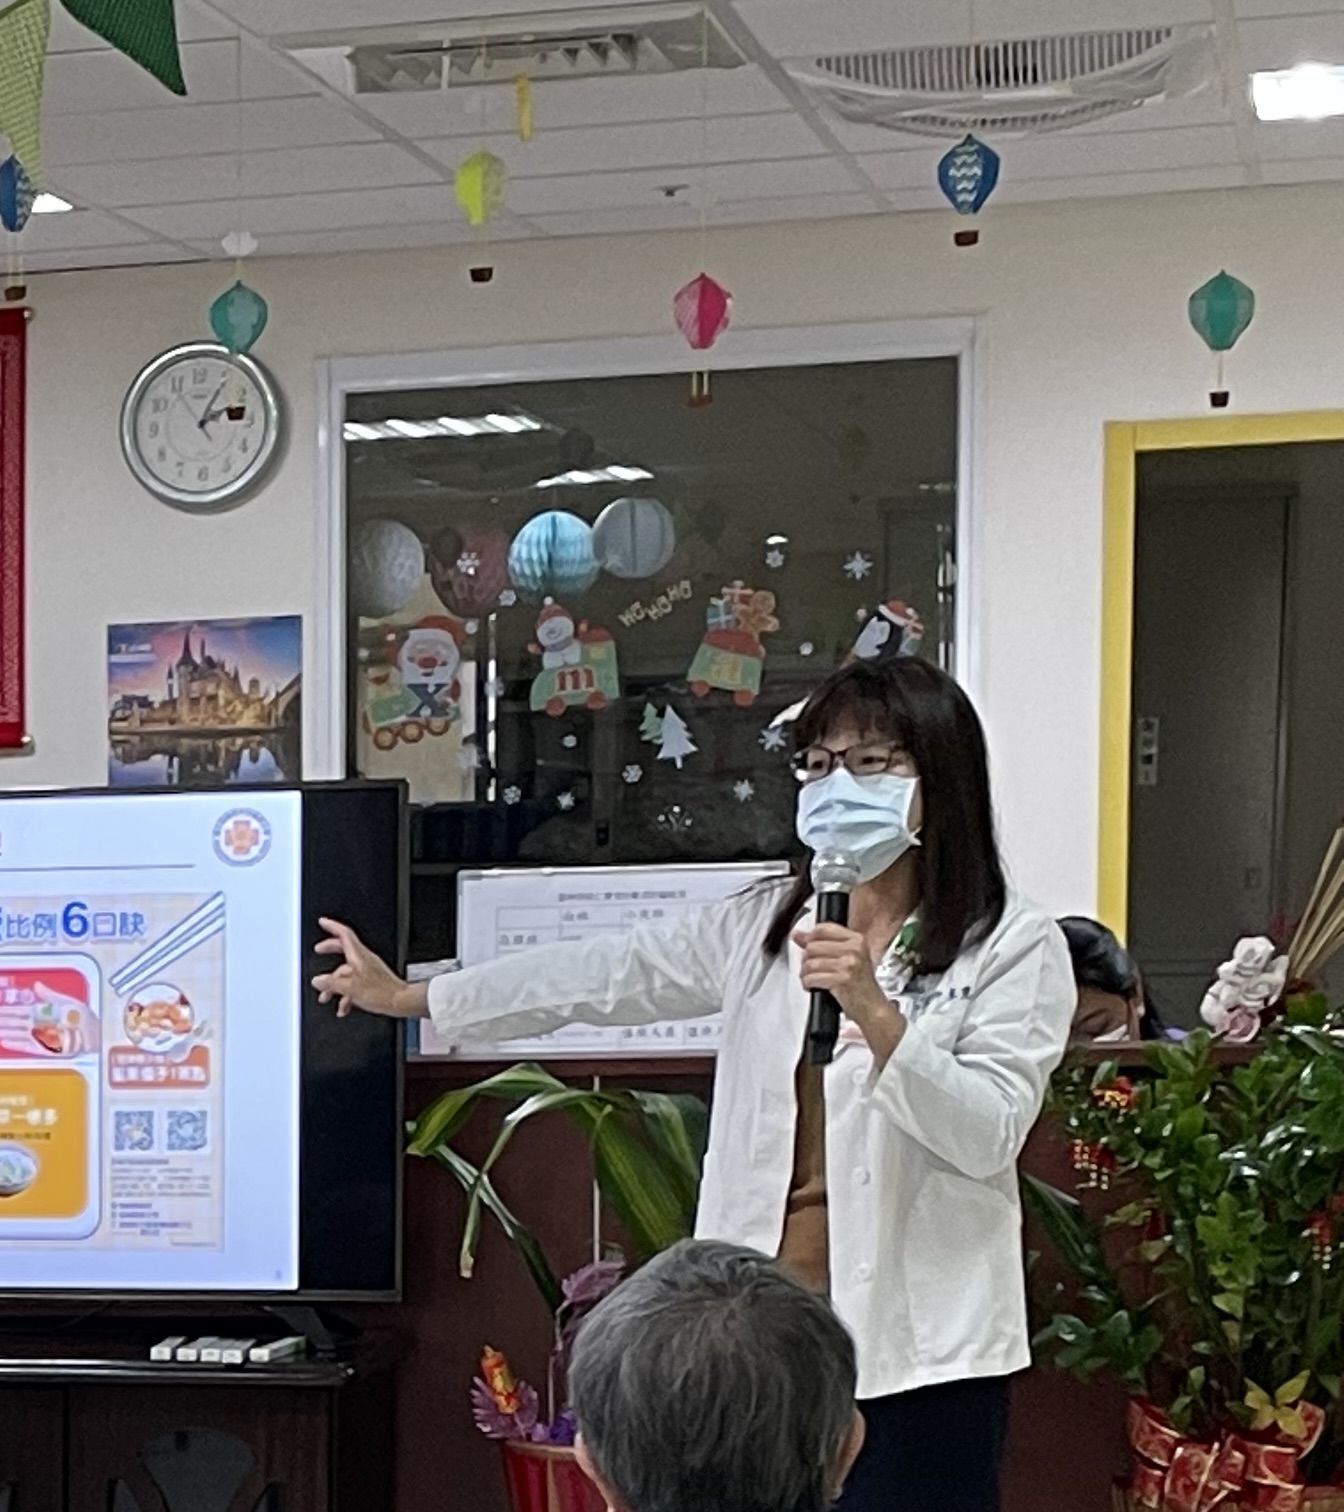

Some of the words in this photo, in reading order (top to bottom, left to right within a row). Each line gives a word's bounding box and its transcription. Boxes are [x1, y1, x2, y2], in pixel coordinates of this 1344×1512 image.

[171, 376, 185, 393] 11
[192, 368, 208, 385] 12
[152, 398, 169, 414] 10
[148, 421, 160, 439] 9
[238, 437, 249, 453] 4
[158, 447, 167, 462] 8
[175, 461, 185, 478] 7
[223, 457, 232, 473] 5
[197, 466, 209, 482] 6
